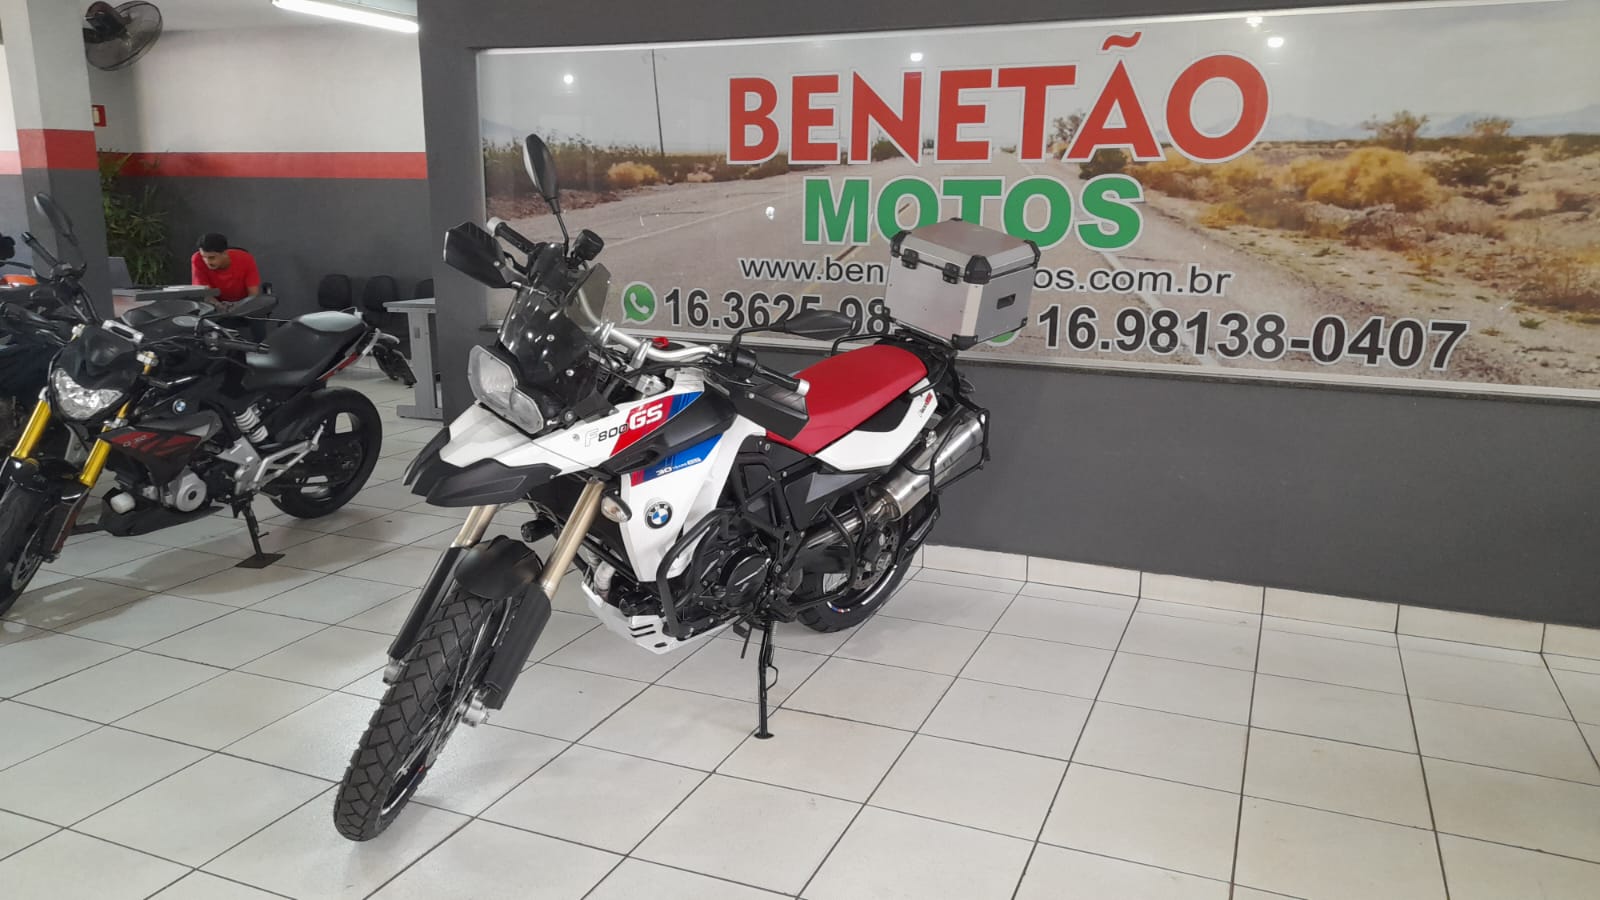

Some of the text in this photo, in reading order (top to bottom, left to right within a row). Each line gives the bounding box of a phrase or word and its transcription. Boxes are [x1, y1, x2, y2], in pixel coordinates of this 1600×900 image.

[728, 31, 1269, 163] BENETÃO
[804, 176, 1143, 249] MOTOS
[741, 256, 1231, 294] www.benos.com.br
[1038, 305, 1468, 370] 16.98138-0407
